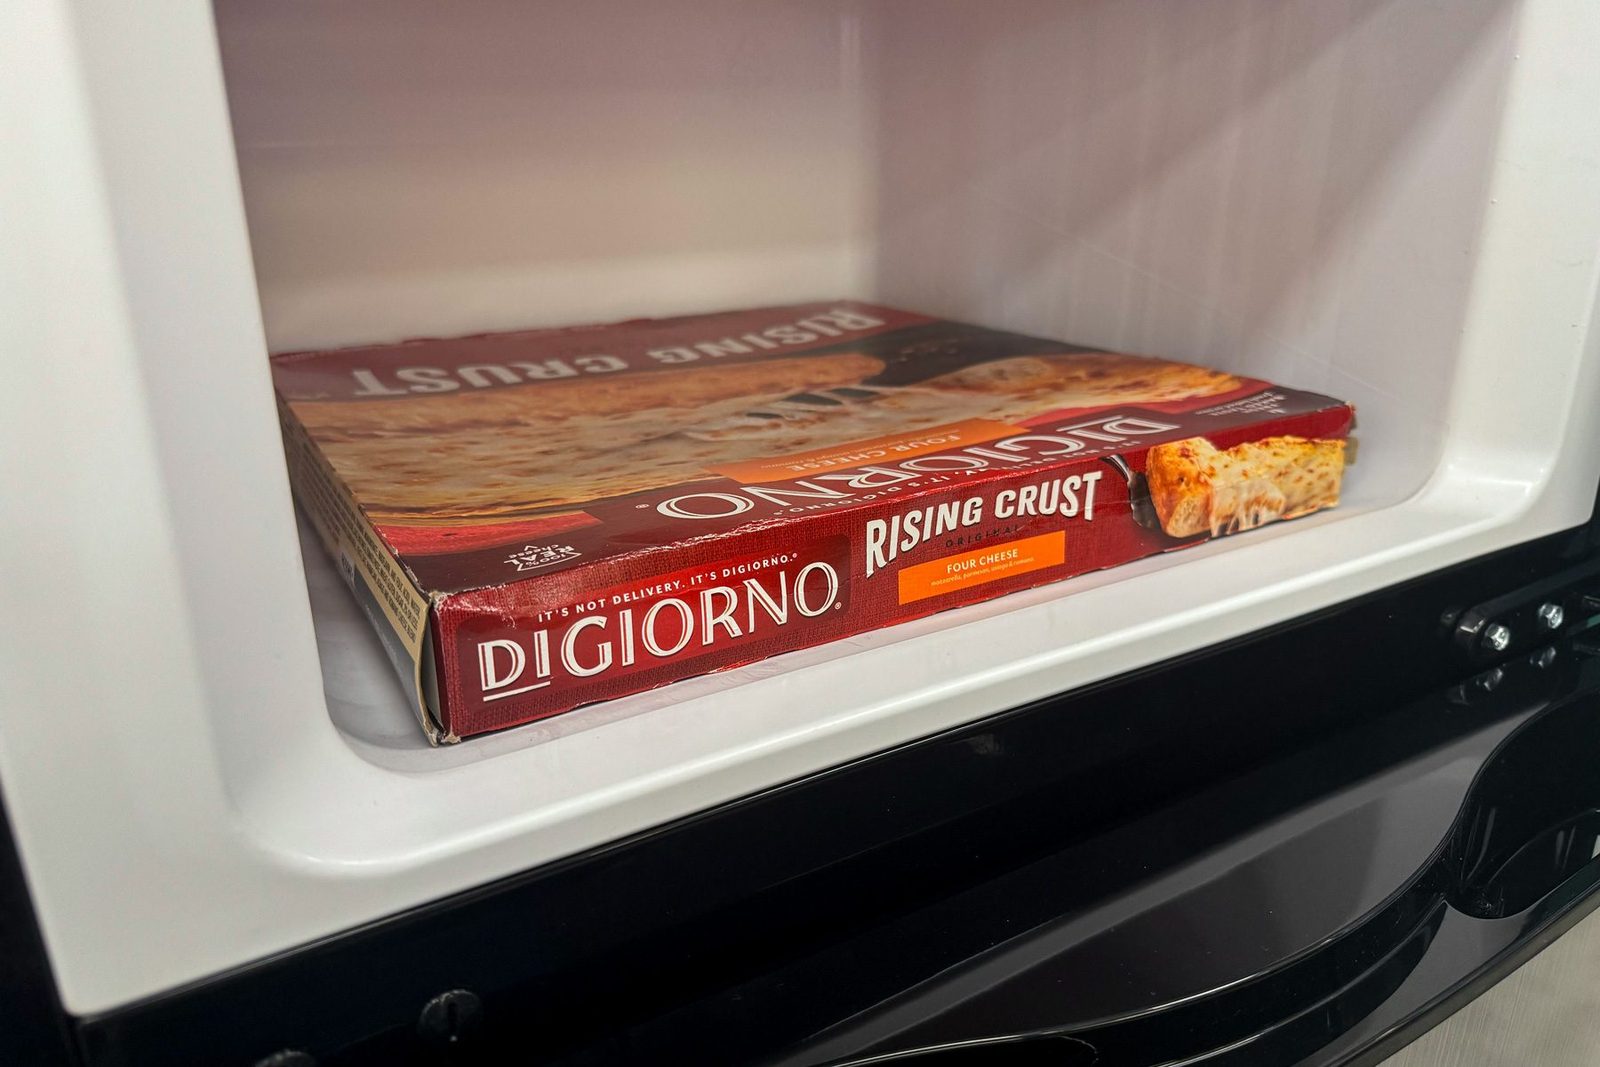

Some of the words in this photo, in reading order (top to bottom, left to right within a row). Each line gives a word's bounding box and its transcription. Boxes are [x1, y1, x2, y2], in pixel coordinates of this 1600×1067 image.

[647, 308, 886, 364] RISING
[352, 354, 630, 396] CRUST
[787, 449, 887, 472] CHEESE
[894, 434, 962, 453] FOUR
[655, 414, 1182, 520] DIGIORNO
[907, 474, 950, 488] IT'S
[866, 496, 984, 580] RISING
[994, 470, 1103, 522] CRUST
[945, 524, 1021, 549] ORIGINAL
[503, 545, 575, 565] REAL
[946, 558, 977, 575] FOUR
[978, 548, 1019, 567] CHEESE
[537, 606, 570, 623] IT'S
[575, 598, 606, 615] NOT
[612, 579, 686, 605] DELIVERY.
[690, 570, 718, 586] IT'S
[476, 561, 839, 694] DIGIORNO
